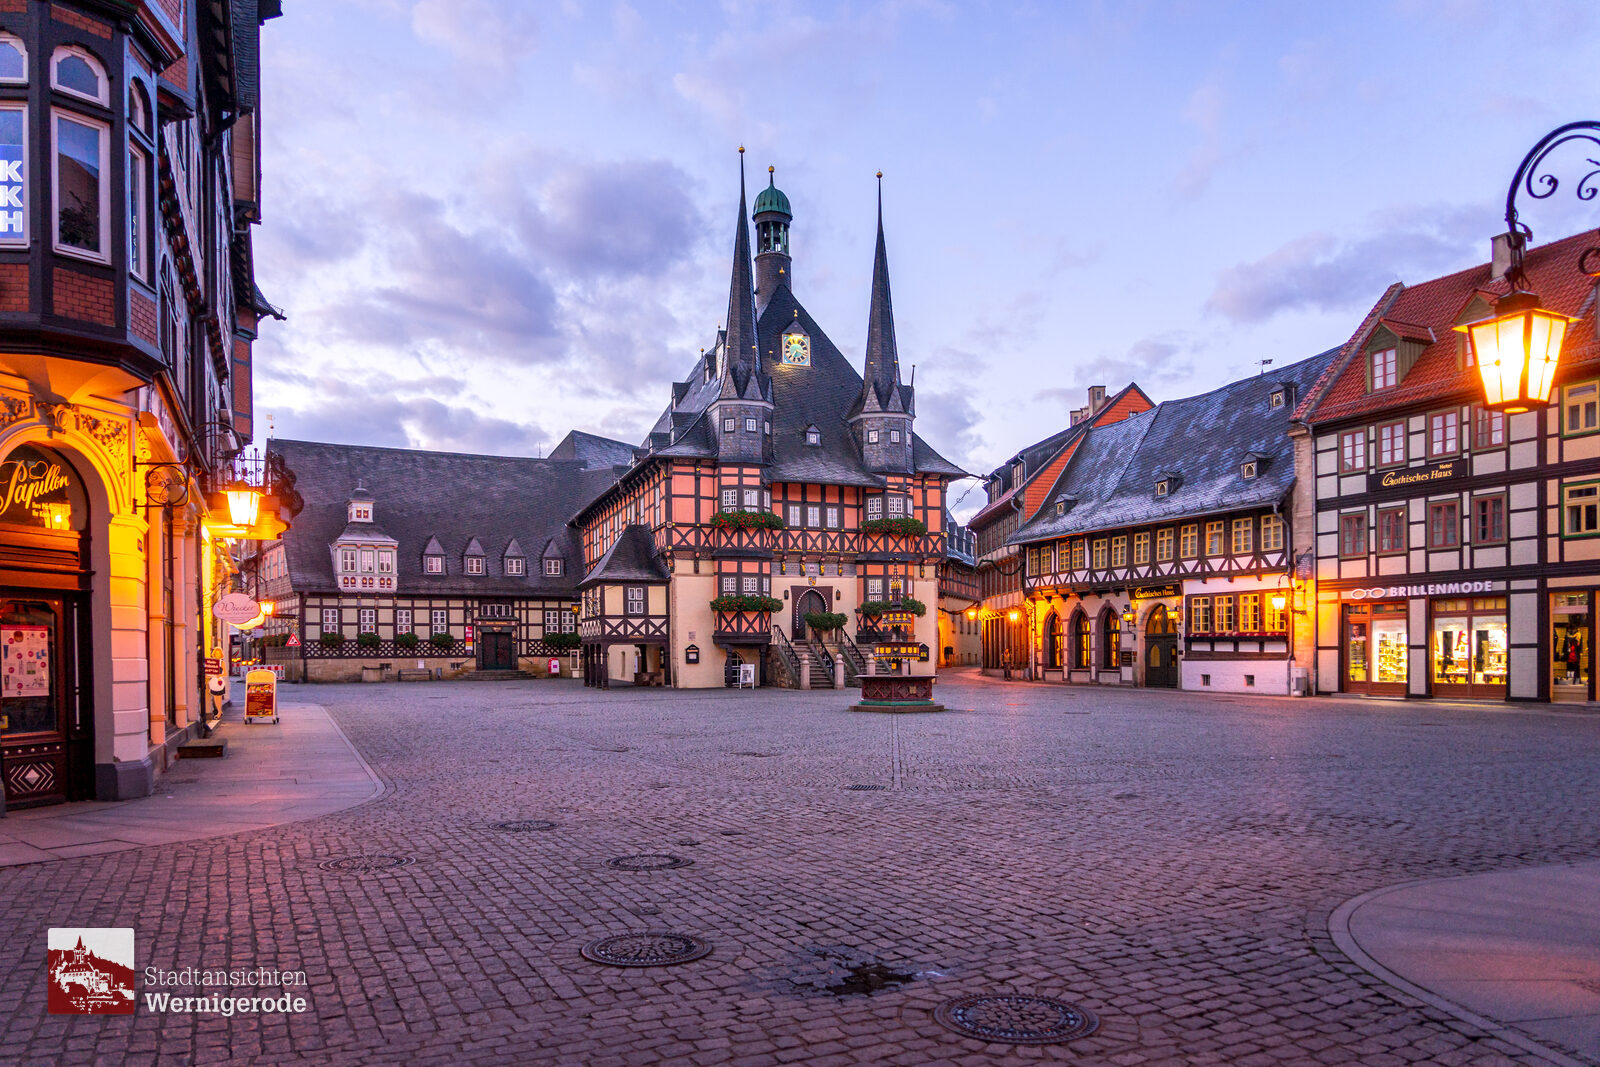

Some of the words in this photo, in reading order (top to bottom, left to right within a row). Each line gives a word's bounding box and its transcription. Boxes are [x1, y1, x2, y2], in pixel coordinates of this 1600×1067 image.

[1382, 472, 1429, 486] Gothisches
[1431, 470, 1453, 479] Haus
[0, 460, 70, 515] Papillon
[1390, 581, 1492, 597] BRILLENMODE
